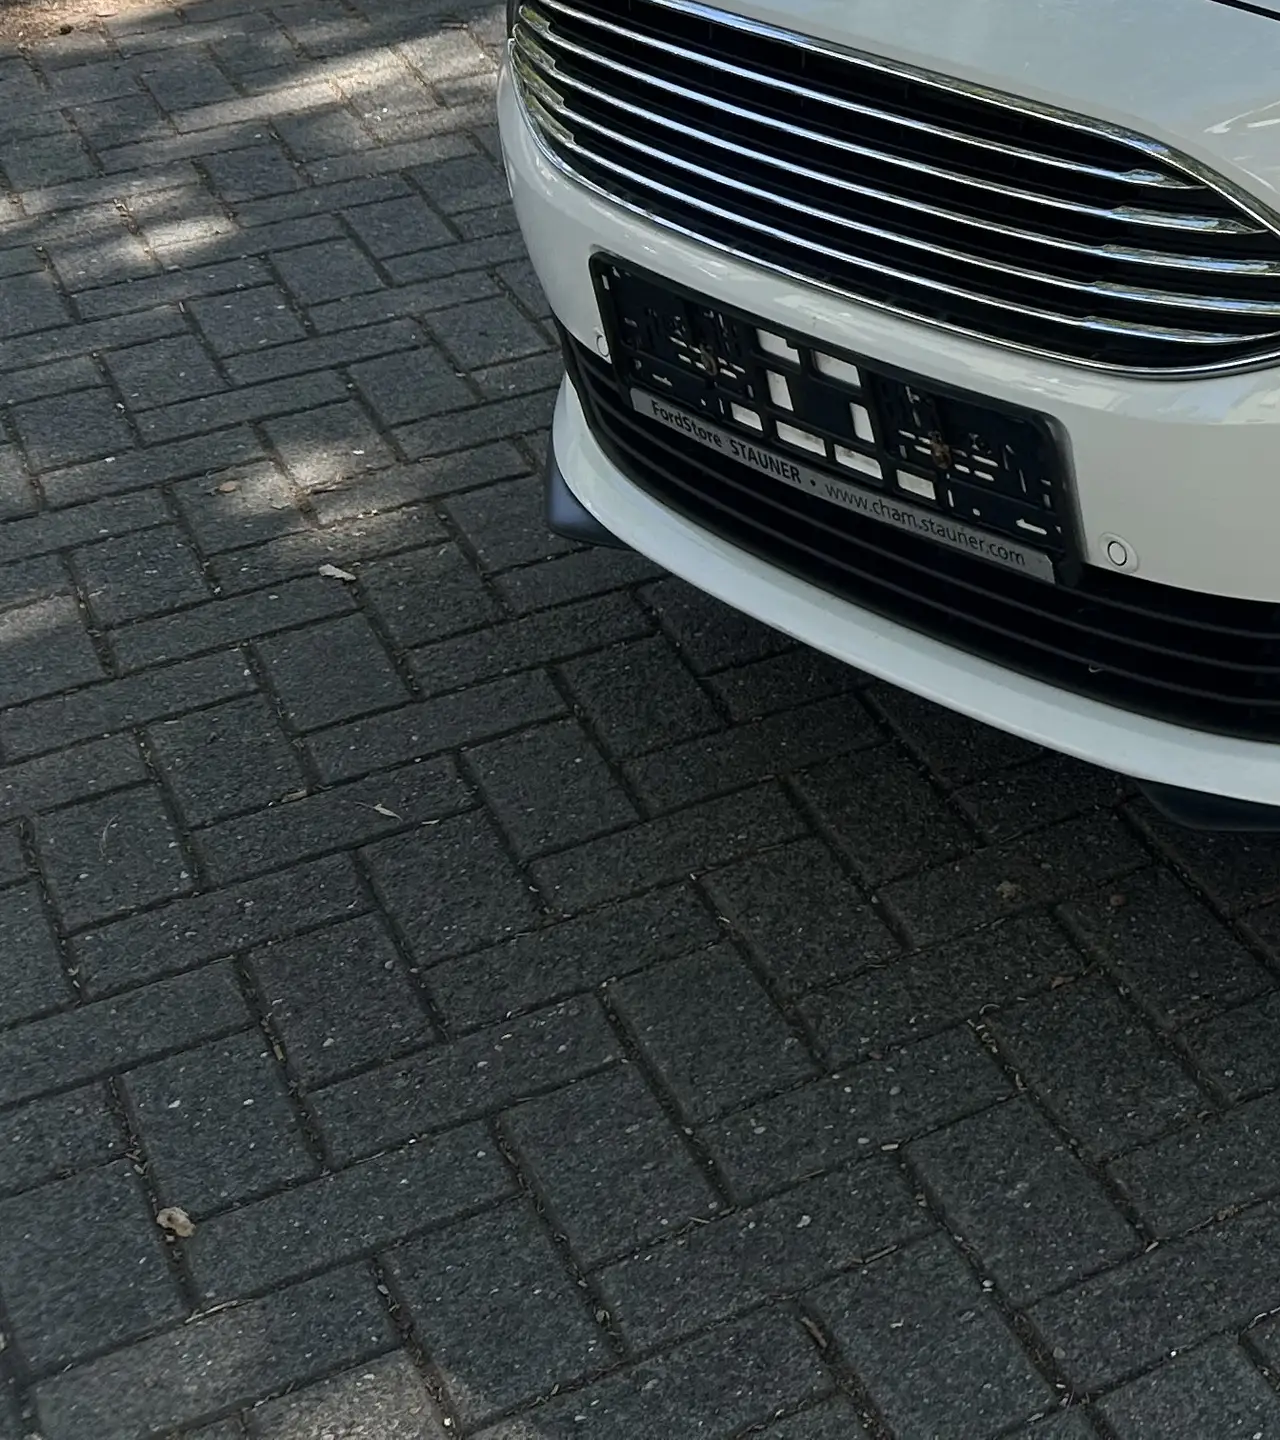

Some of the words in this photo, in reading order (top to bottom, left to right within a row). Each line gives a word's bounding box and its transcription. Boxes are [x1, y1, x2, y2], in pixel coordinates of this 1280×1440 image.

[651, 399, 722, 448] FordStore
[730, 438, 802, 484] STAUNER
[824, 482, 1026, 566] www.cham.stauner.com
